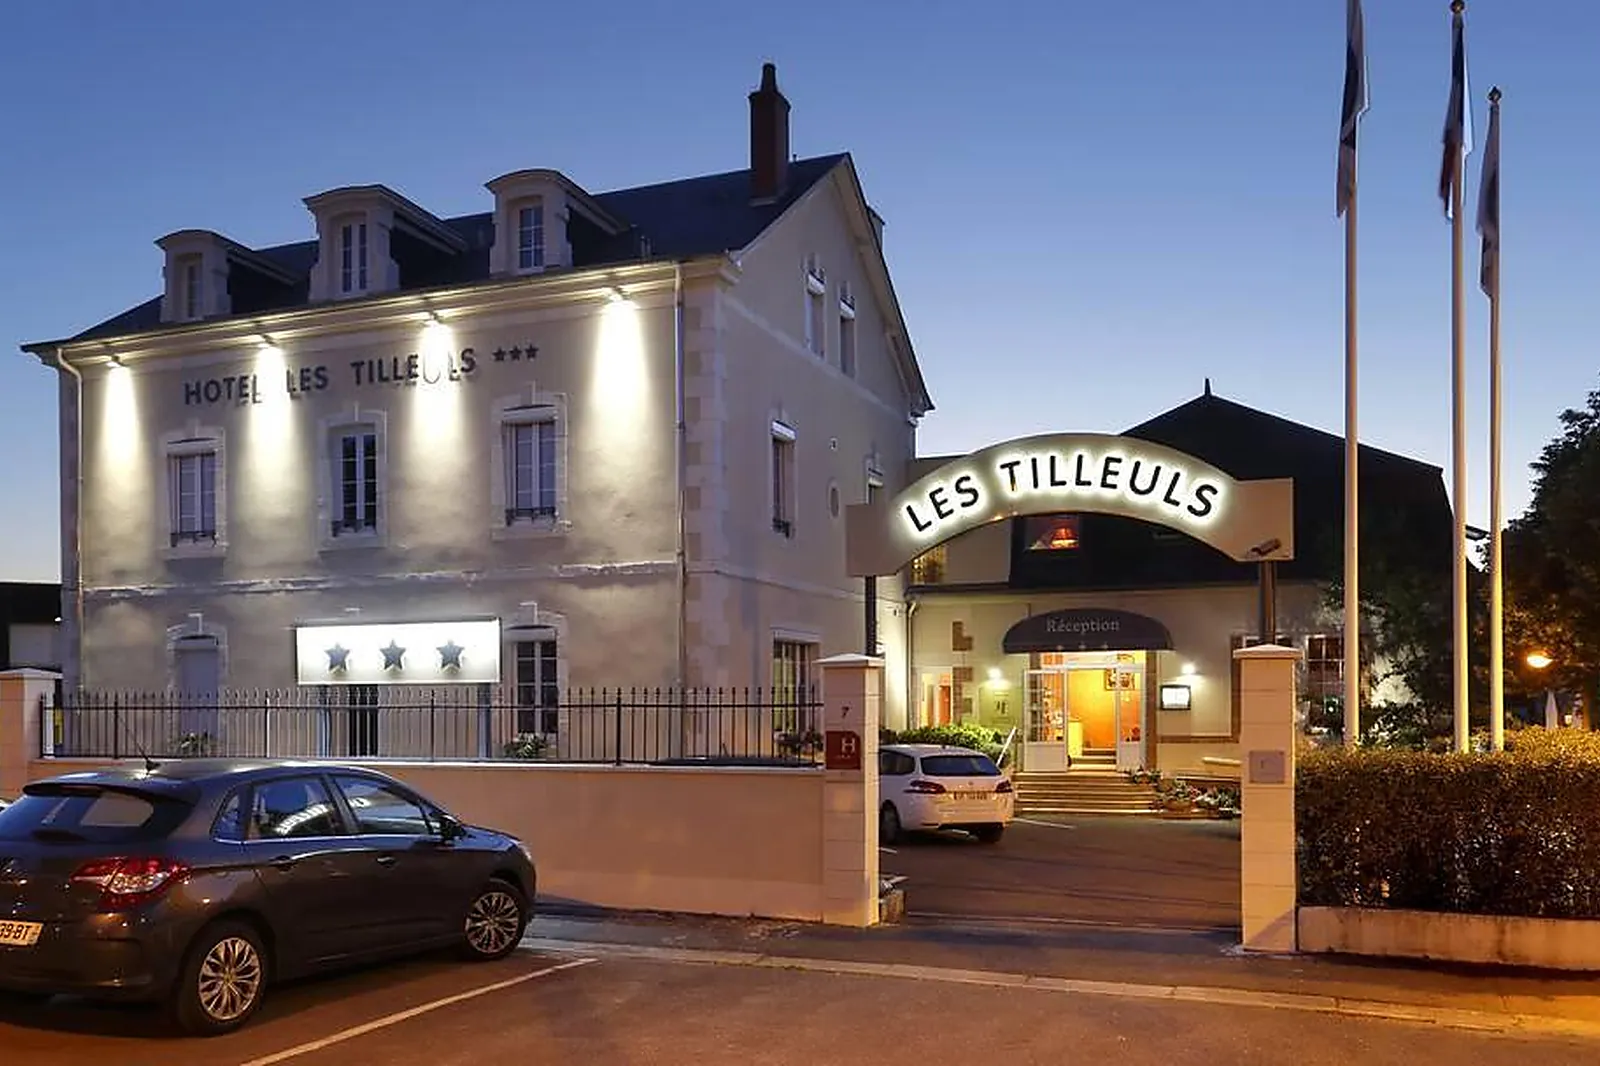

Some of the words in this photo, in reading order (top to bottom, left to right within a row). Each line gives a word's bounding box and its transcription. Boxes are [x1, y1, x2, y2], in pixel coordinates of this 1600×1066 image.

[185, 374, 261, 404] HOTEL
[286, 363, 329, 398] LES
[906, 475, 979, 532] LES
[1000, 454, 1219, 518] TILLEULS
[1046, 617, 1121, 635] Réception
[842, 738, 855, 753] H
